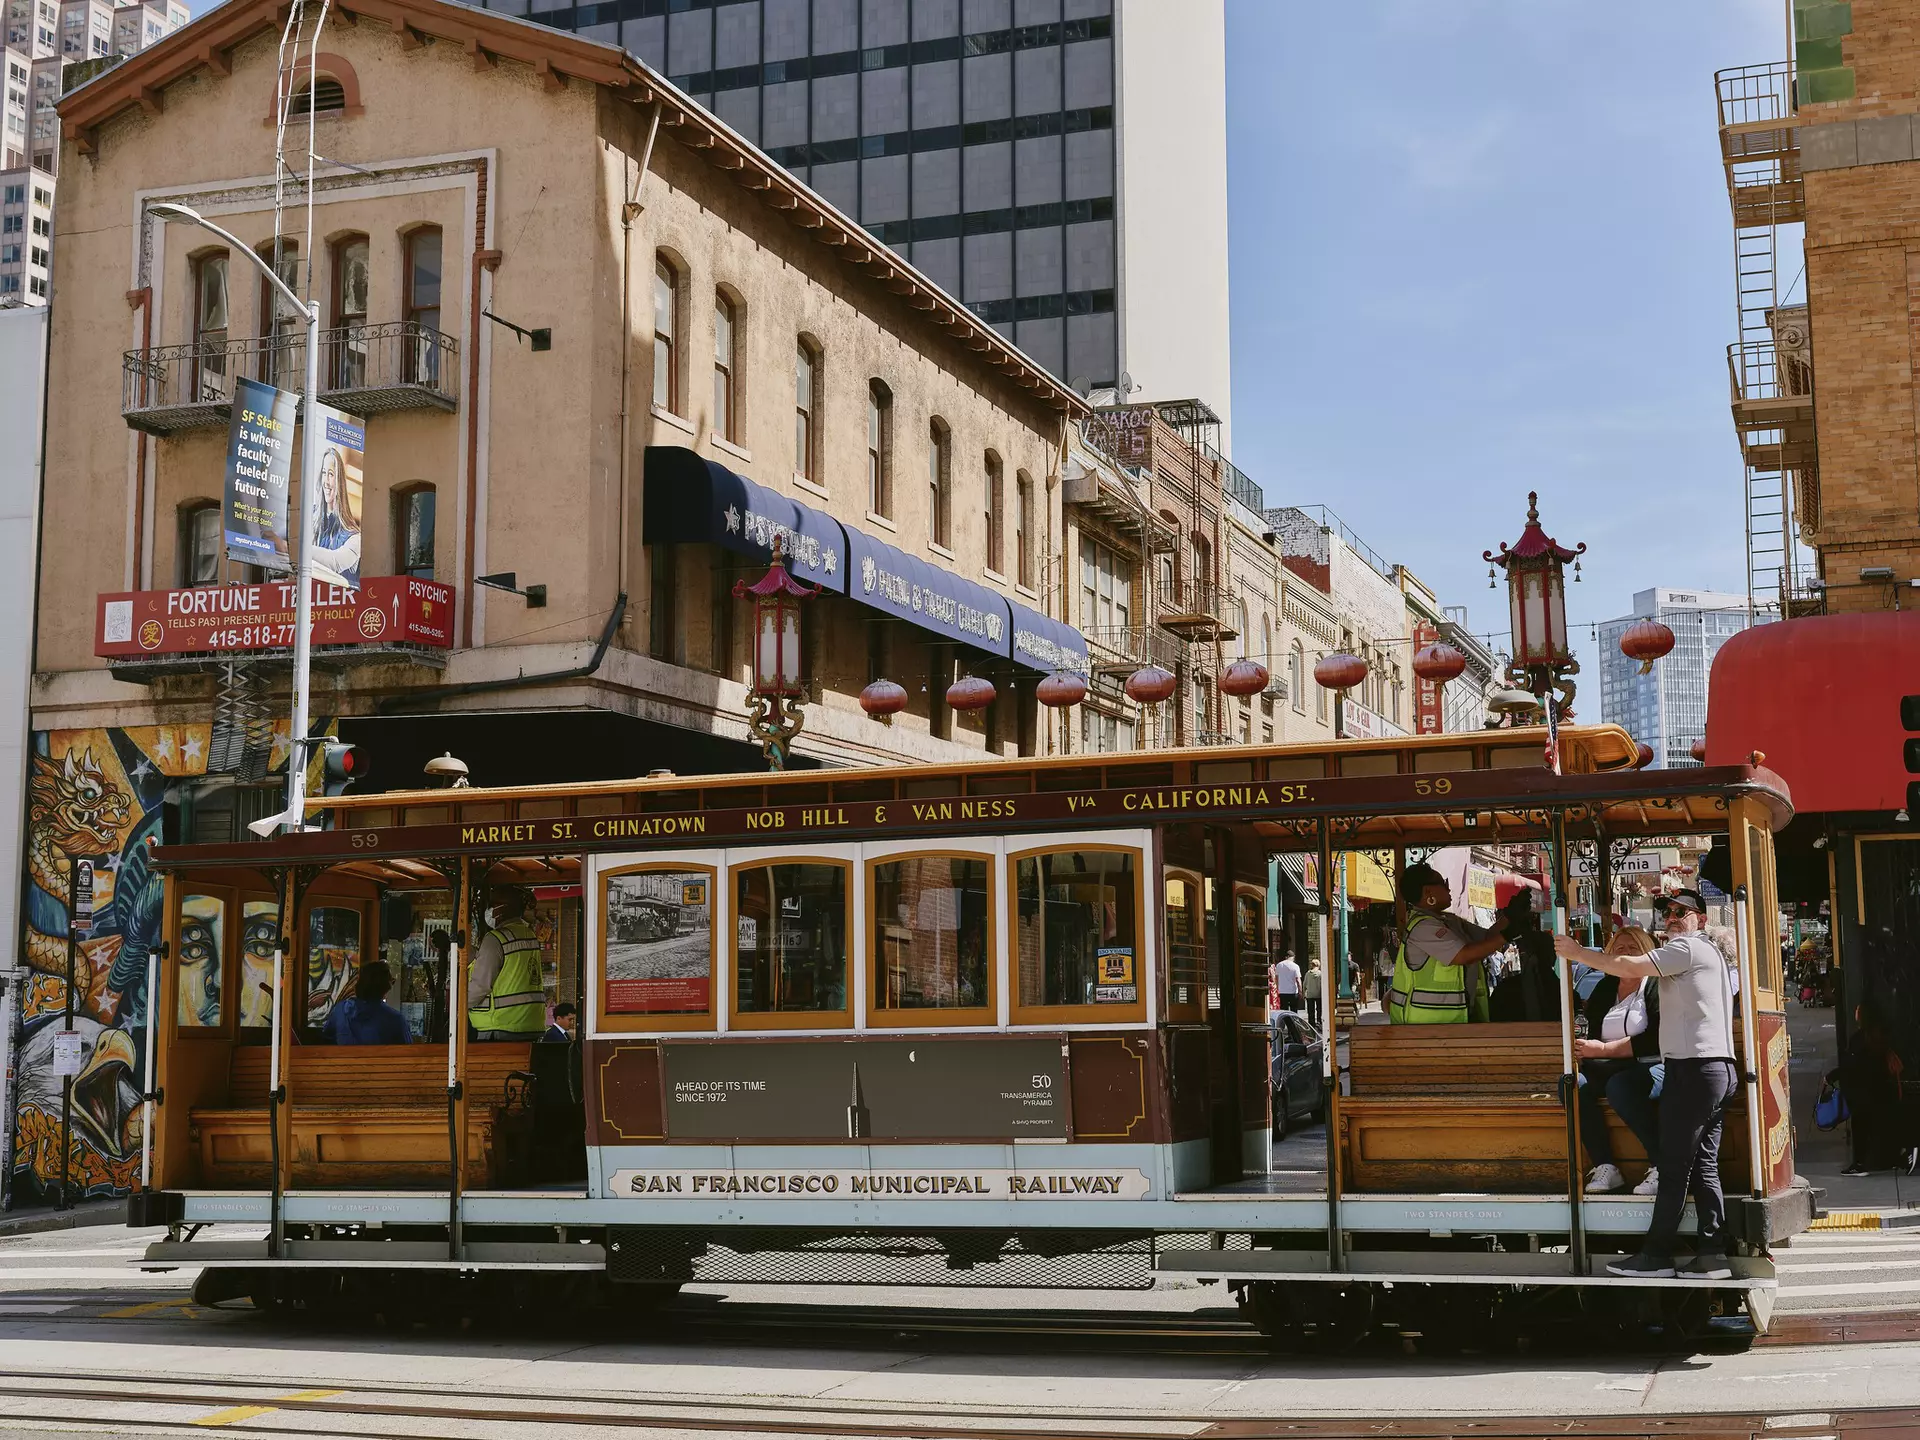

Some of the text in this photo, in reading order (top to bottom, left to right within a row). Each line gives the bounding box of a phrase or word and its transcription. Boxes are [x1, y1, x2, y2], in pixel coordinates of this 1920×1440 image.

[241, 409, 282, 432] SF State
[239, 426, 281, 450] is where
[337, 425, 363, 440] FRANCISCO
[339, 434, 362, 447] UNIVERSITY
[237, 444, 273, 467] faculty
[236, 461, 285, 489] fueled my
[235, 479, 269, 499] future.
[234, 511, 243, 519] Tell
[250, 506, 262, 514] your
[261, 509, 277, 518] story?
[167, 587, 261, 615] FORTUNE
[409, 581, 448, 604] PSYCHIC
[911, 584, 922, 612] &
[923, 588, 957, 625] TAROT
[167, 618, 195, 629] TELLS
[223, 614, 267, 627] PRESENT
[269, 611, 296, 624] FUTU
[310, 610, 322, 621] BY
[324, 608, 356, 620] HOLLY
[362, 611, 382, 633] 樂
[143, 622, 159, 645] 愛
[208, 624, 315, 647] 415-818-777
[1414, 778, 1452, 795] 59
[462, 825, 536, 844] MARKET
[551, 822, 578, 840] ST.
[593, 816, 706, 838] CHINATOWN
[746, 811, 785, 829] NOB
[802, 808, 849, 826] HILL
[875, 806, 887, 824] &
[912, 802, 952, 821] VAN
[961, 800, 1016, 819] NESS
[1123, 787, 1270, 811] CALIFORNIA
[1280, 784, 1315, 804] ST.
[350, 833, 379, 849] 59
[740, 923, 756, 932] ANY
[675, 1081, 766, 1091] AHEAD OF ITS TIME
[675, 1093, 727, 1102] SINCE 1972
[631, 1175, 1125, 1194] SAN FRANCISCO MUNICIPAL RAILWAY
[210, 1204, 244, 1212] STANDEES
[246, 1204, 263, 1212] ONLY
[381, 1204, 401, 1212] ONLY
[1428, 1211, 1476, 1219] STANDEES
[1478, 1211, 1503, 1219] ONLY
[1601, 1210, 1653, 1218] TWO STAN
